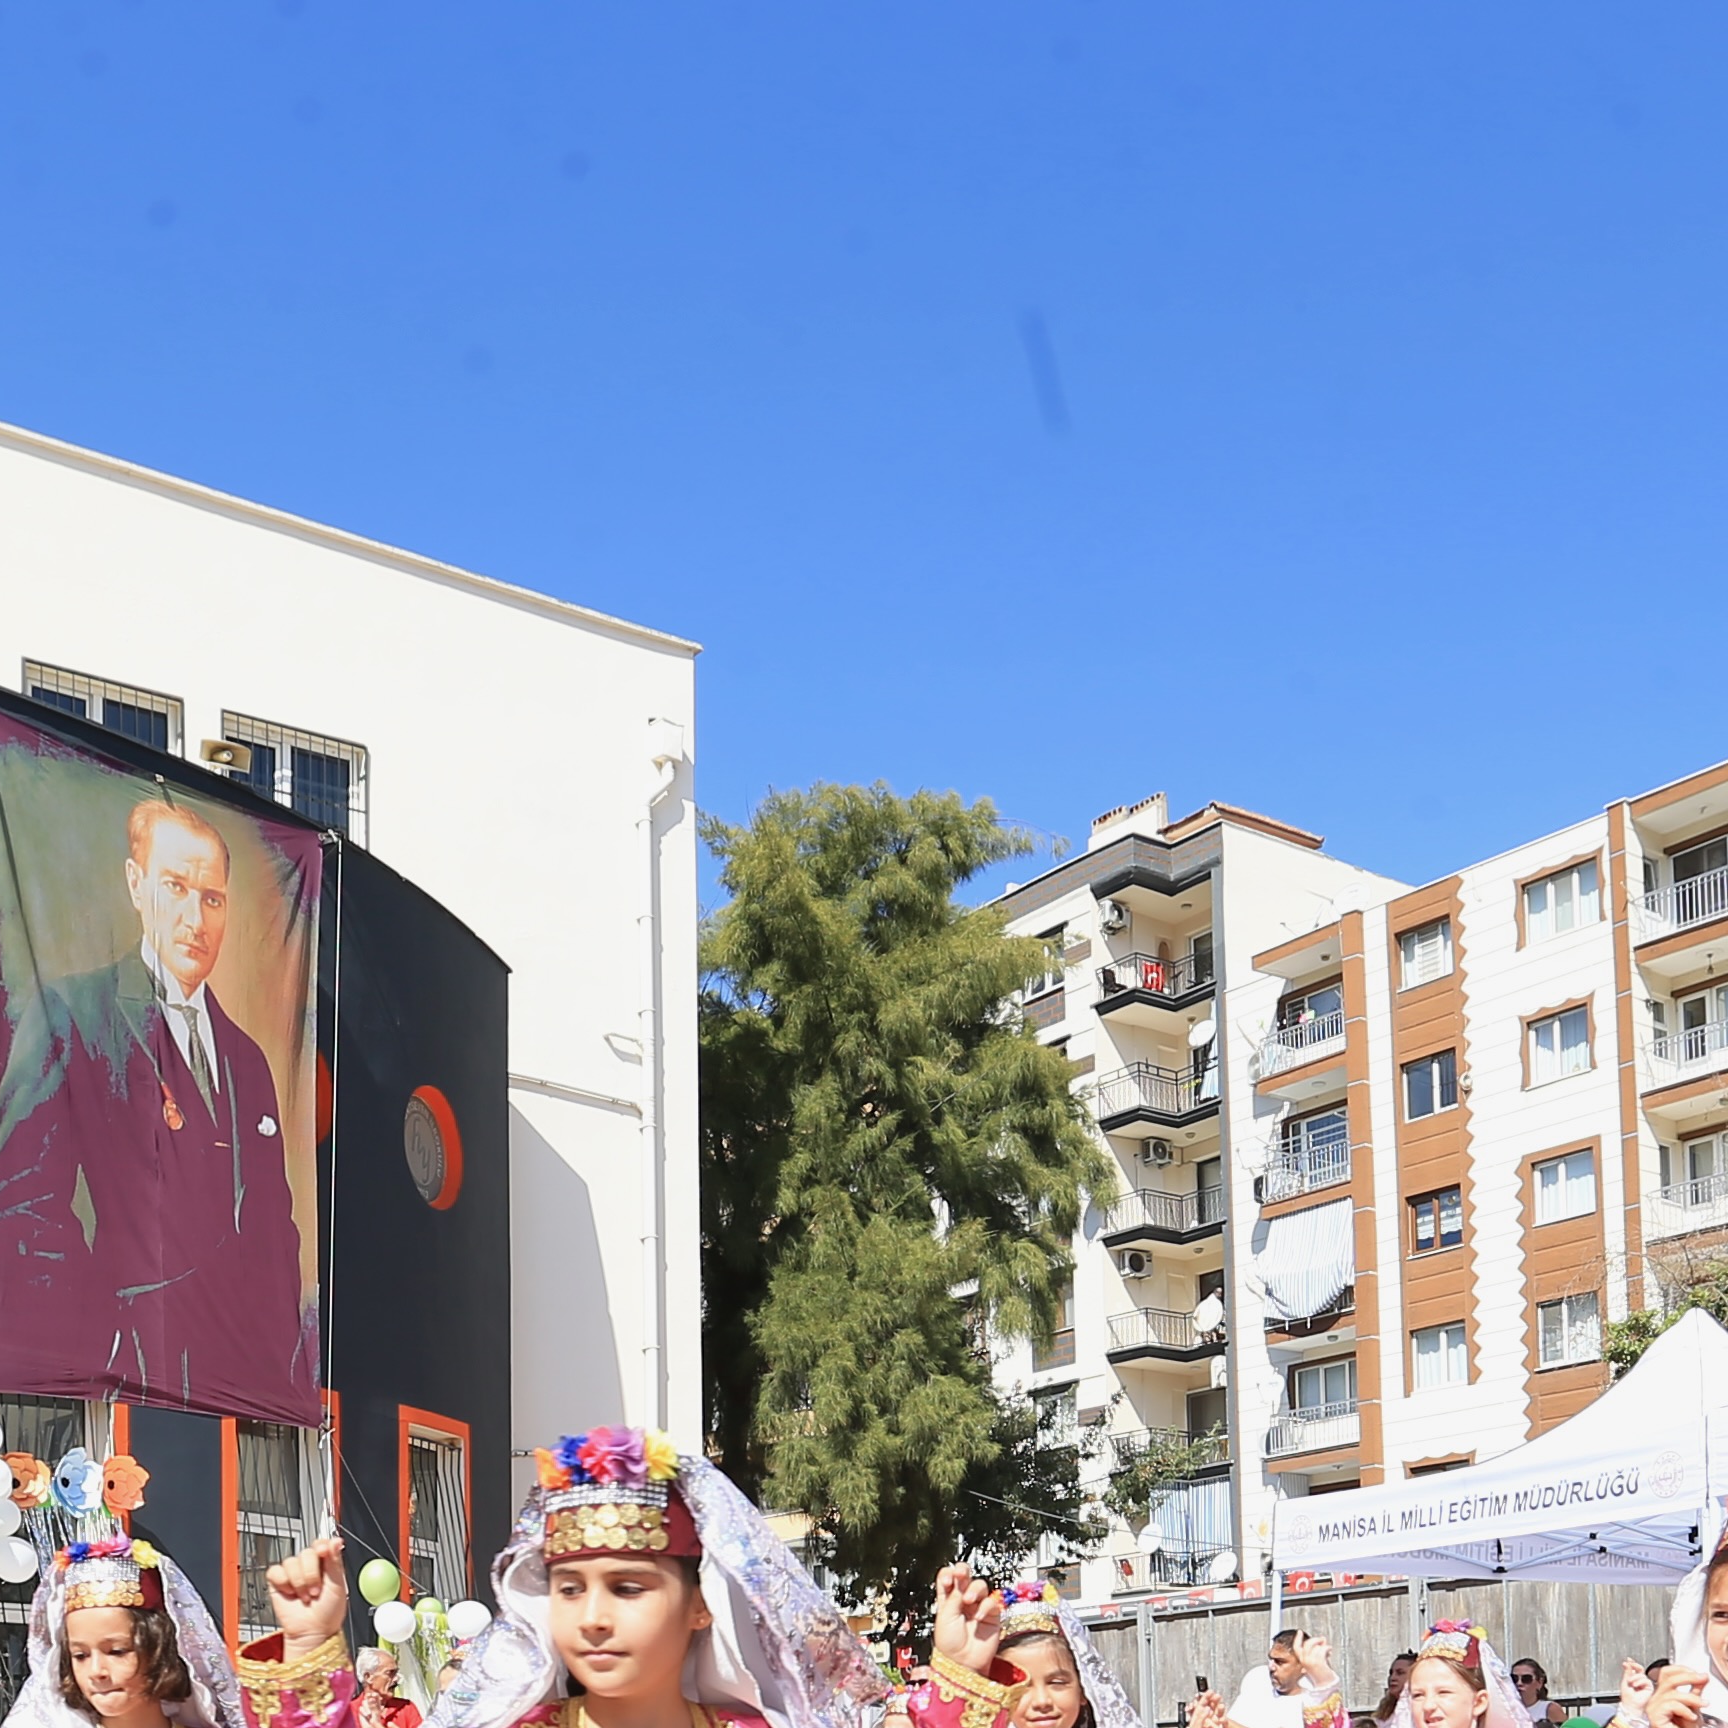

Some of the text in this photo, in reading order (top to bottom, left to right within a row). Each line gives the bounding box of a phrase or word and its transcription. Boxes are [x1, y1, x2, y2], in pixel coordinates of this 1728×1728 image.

[1318, 1467, 1642, 1543] MANİSA İL MİLLİ EĞİTİM MÜDÜRLÜĞÜ
